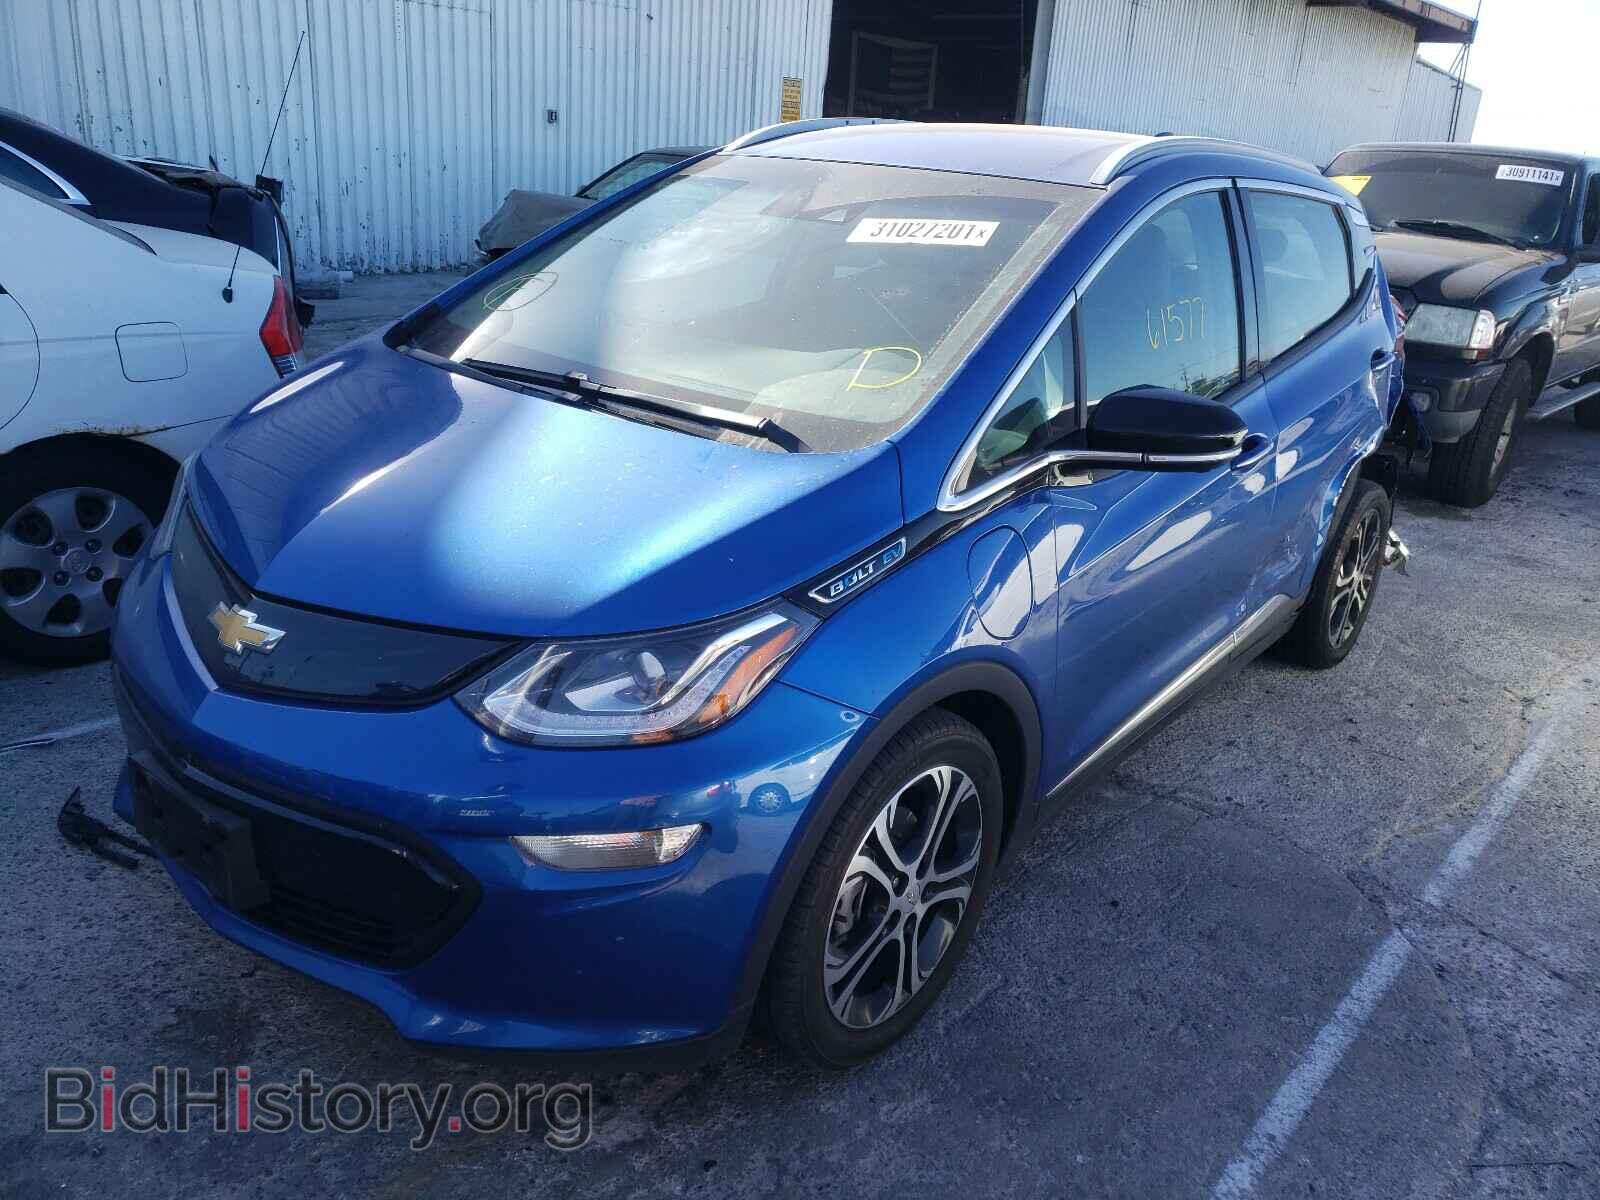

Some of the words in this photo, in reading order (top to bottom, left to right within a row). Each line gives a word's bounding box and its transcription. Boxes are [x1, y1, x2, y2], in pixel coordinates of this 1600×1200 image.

[1146, 297, 1205, 349] 61577
[847, 346, 921, 391] D
[830, 561, 876, 597] BOLT
[882, 543, 902, 565] EV
